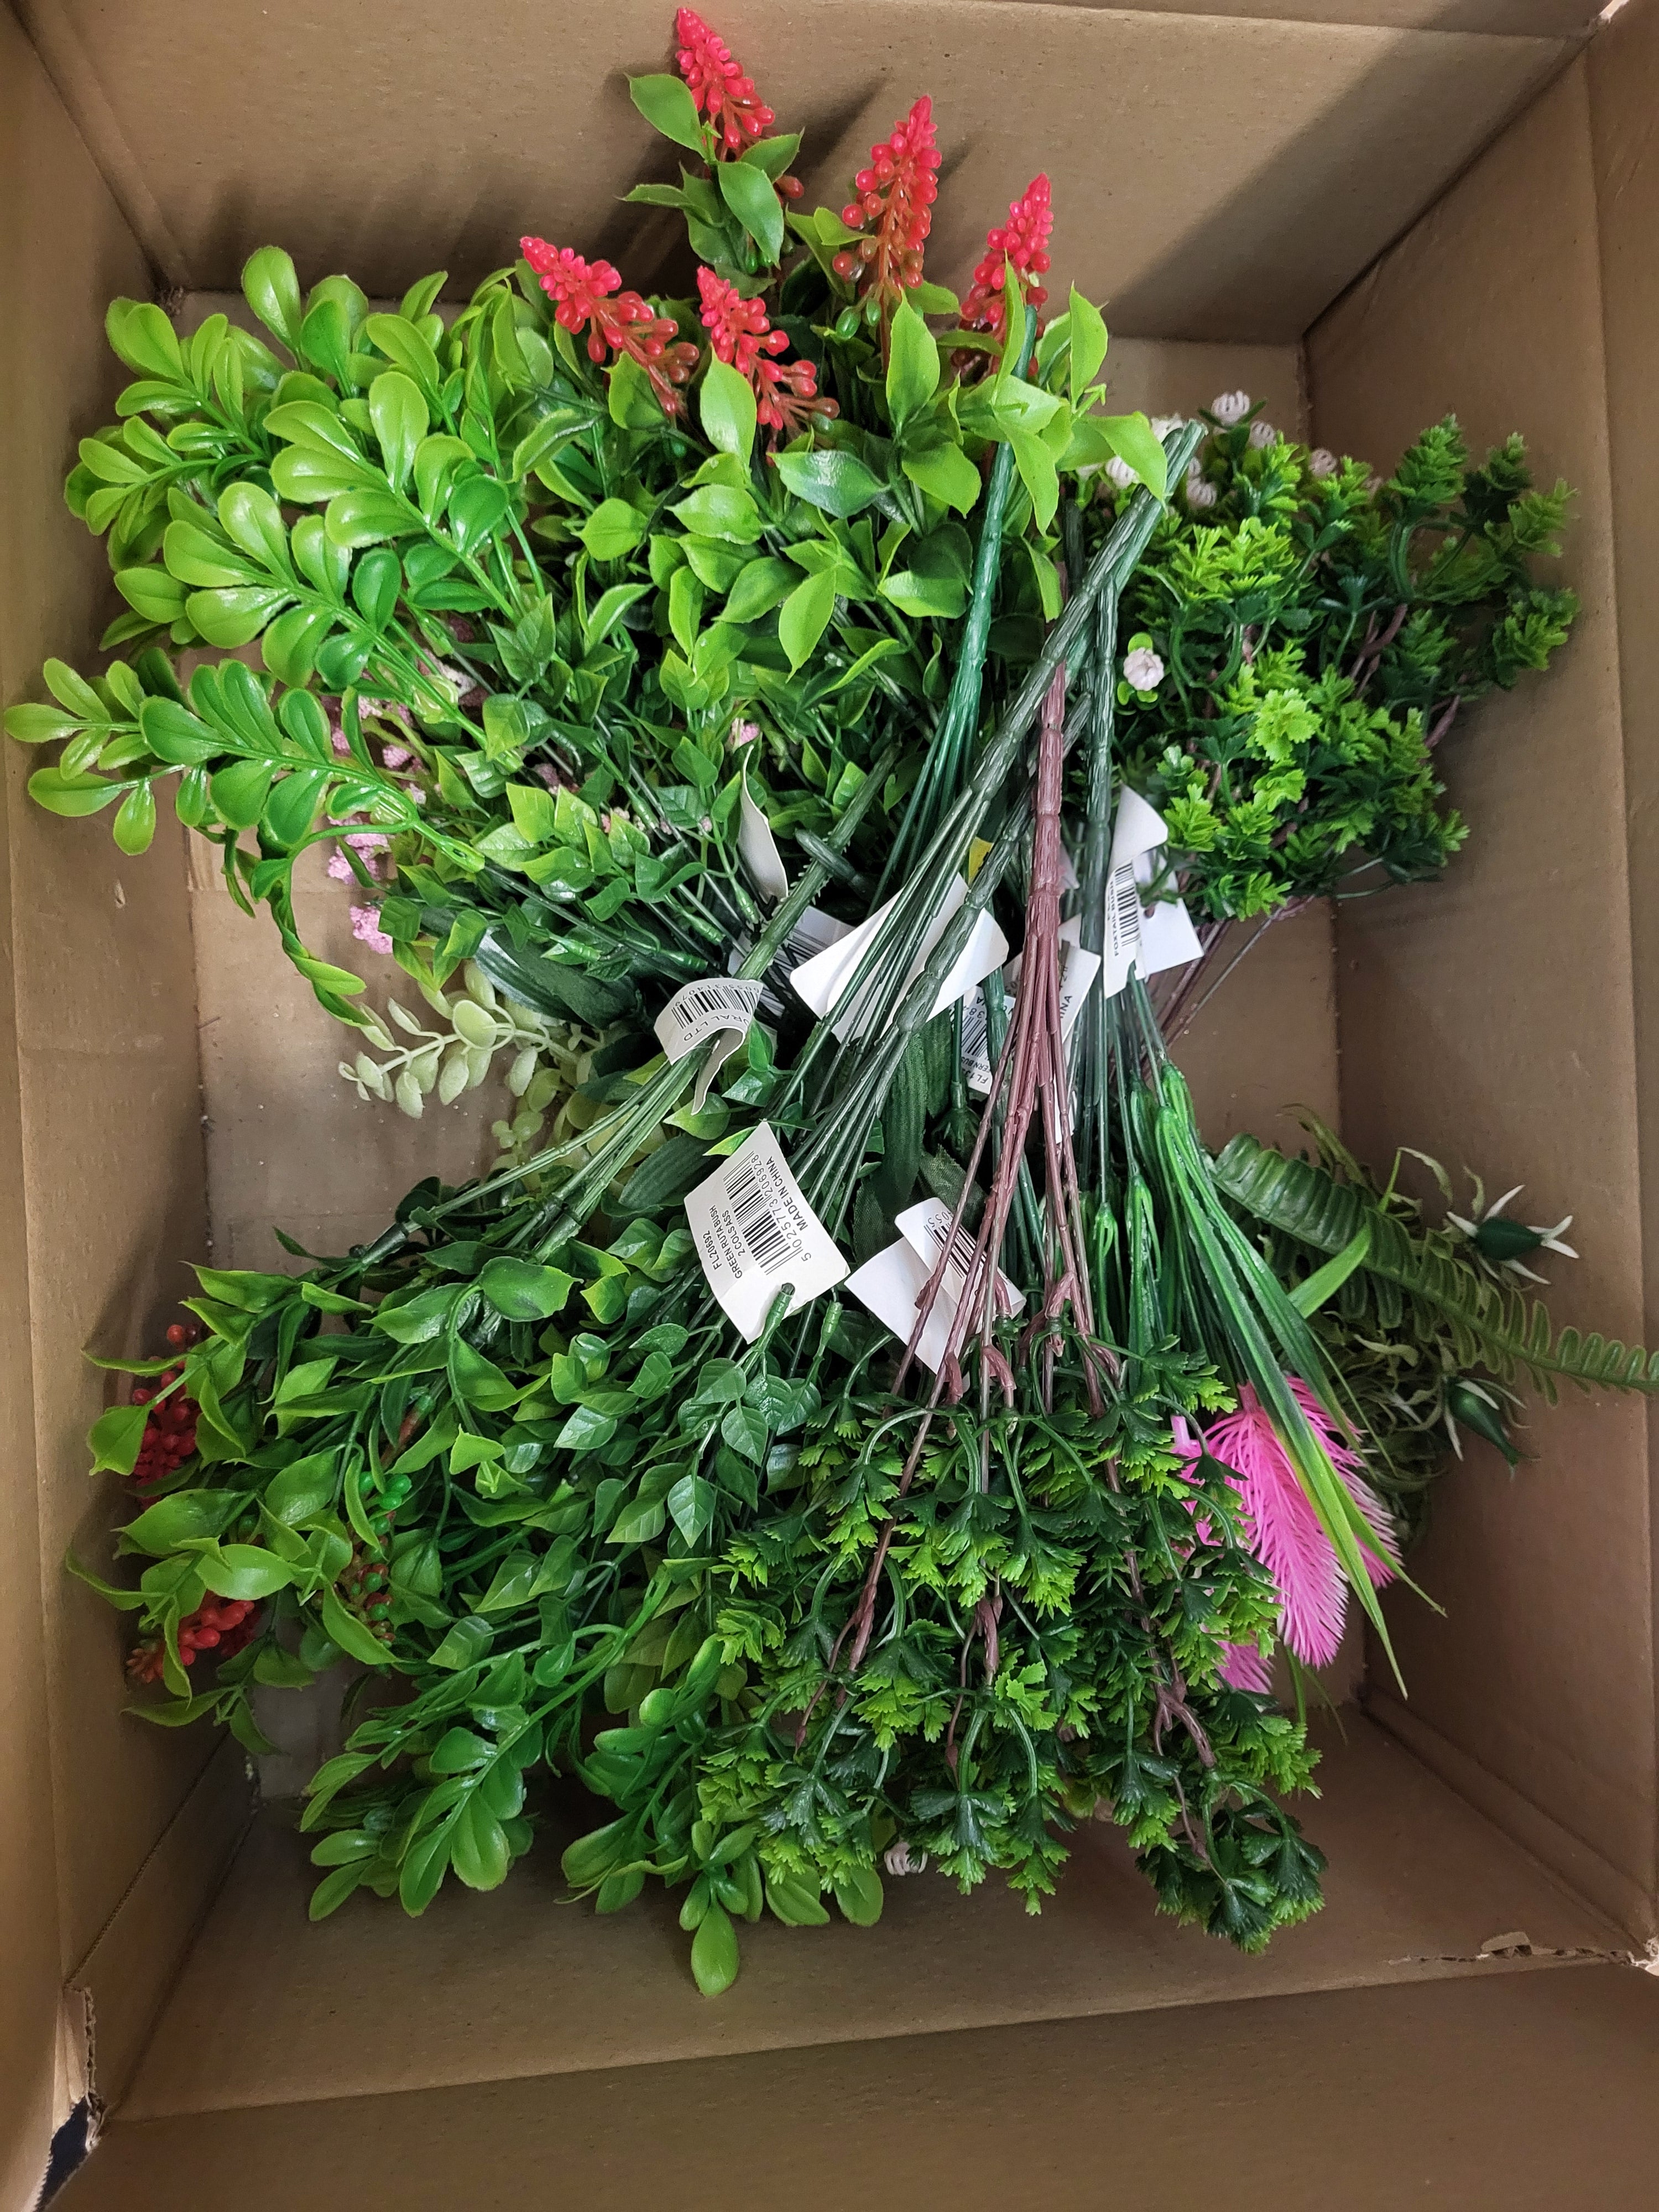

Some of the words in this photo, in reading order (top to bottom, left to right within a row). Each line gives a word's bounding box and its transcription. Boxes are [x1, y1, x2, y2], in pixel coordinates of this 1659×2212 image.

[684, 1021, 708, 1042] LTD
[961, 1056, 974, 1067] BUS
[766, 1156, 783, 1187] CHINA
[778, 1186, 789, 1199] IN
[709, 1204, 721, 1228] BUSH
[722, 1210, 733, 1227] ASS
[783, 1197, 808, 1231] MADE
[716, 1224, 729, 1249] RUTA
[728, 1225, 742, 1250] COLS
[703, 1230, 722, 1270] FL20692
[737, 1248, 745, 1256] 2
[723, 1247, 743, 1279] GREEN
